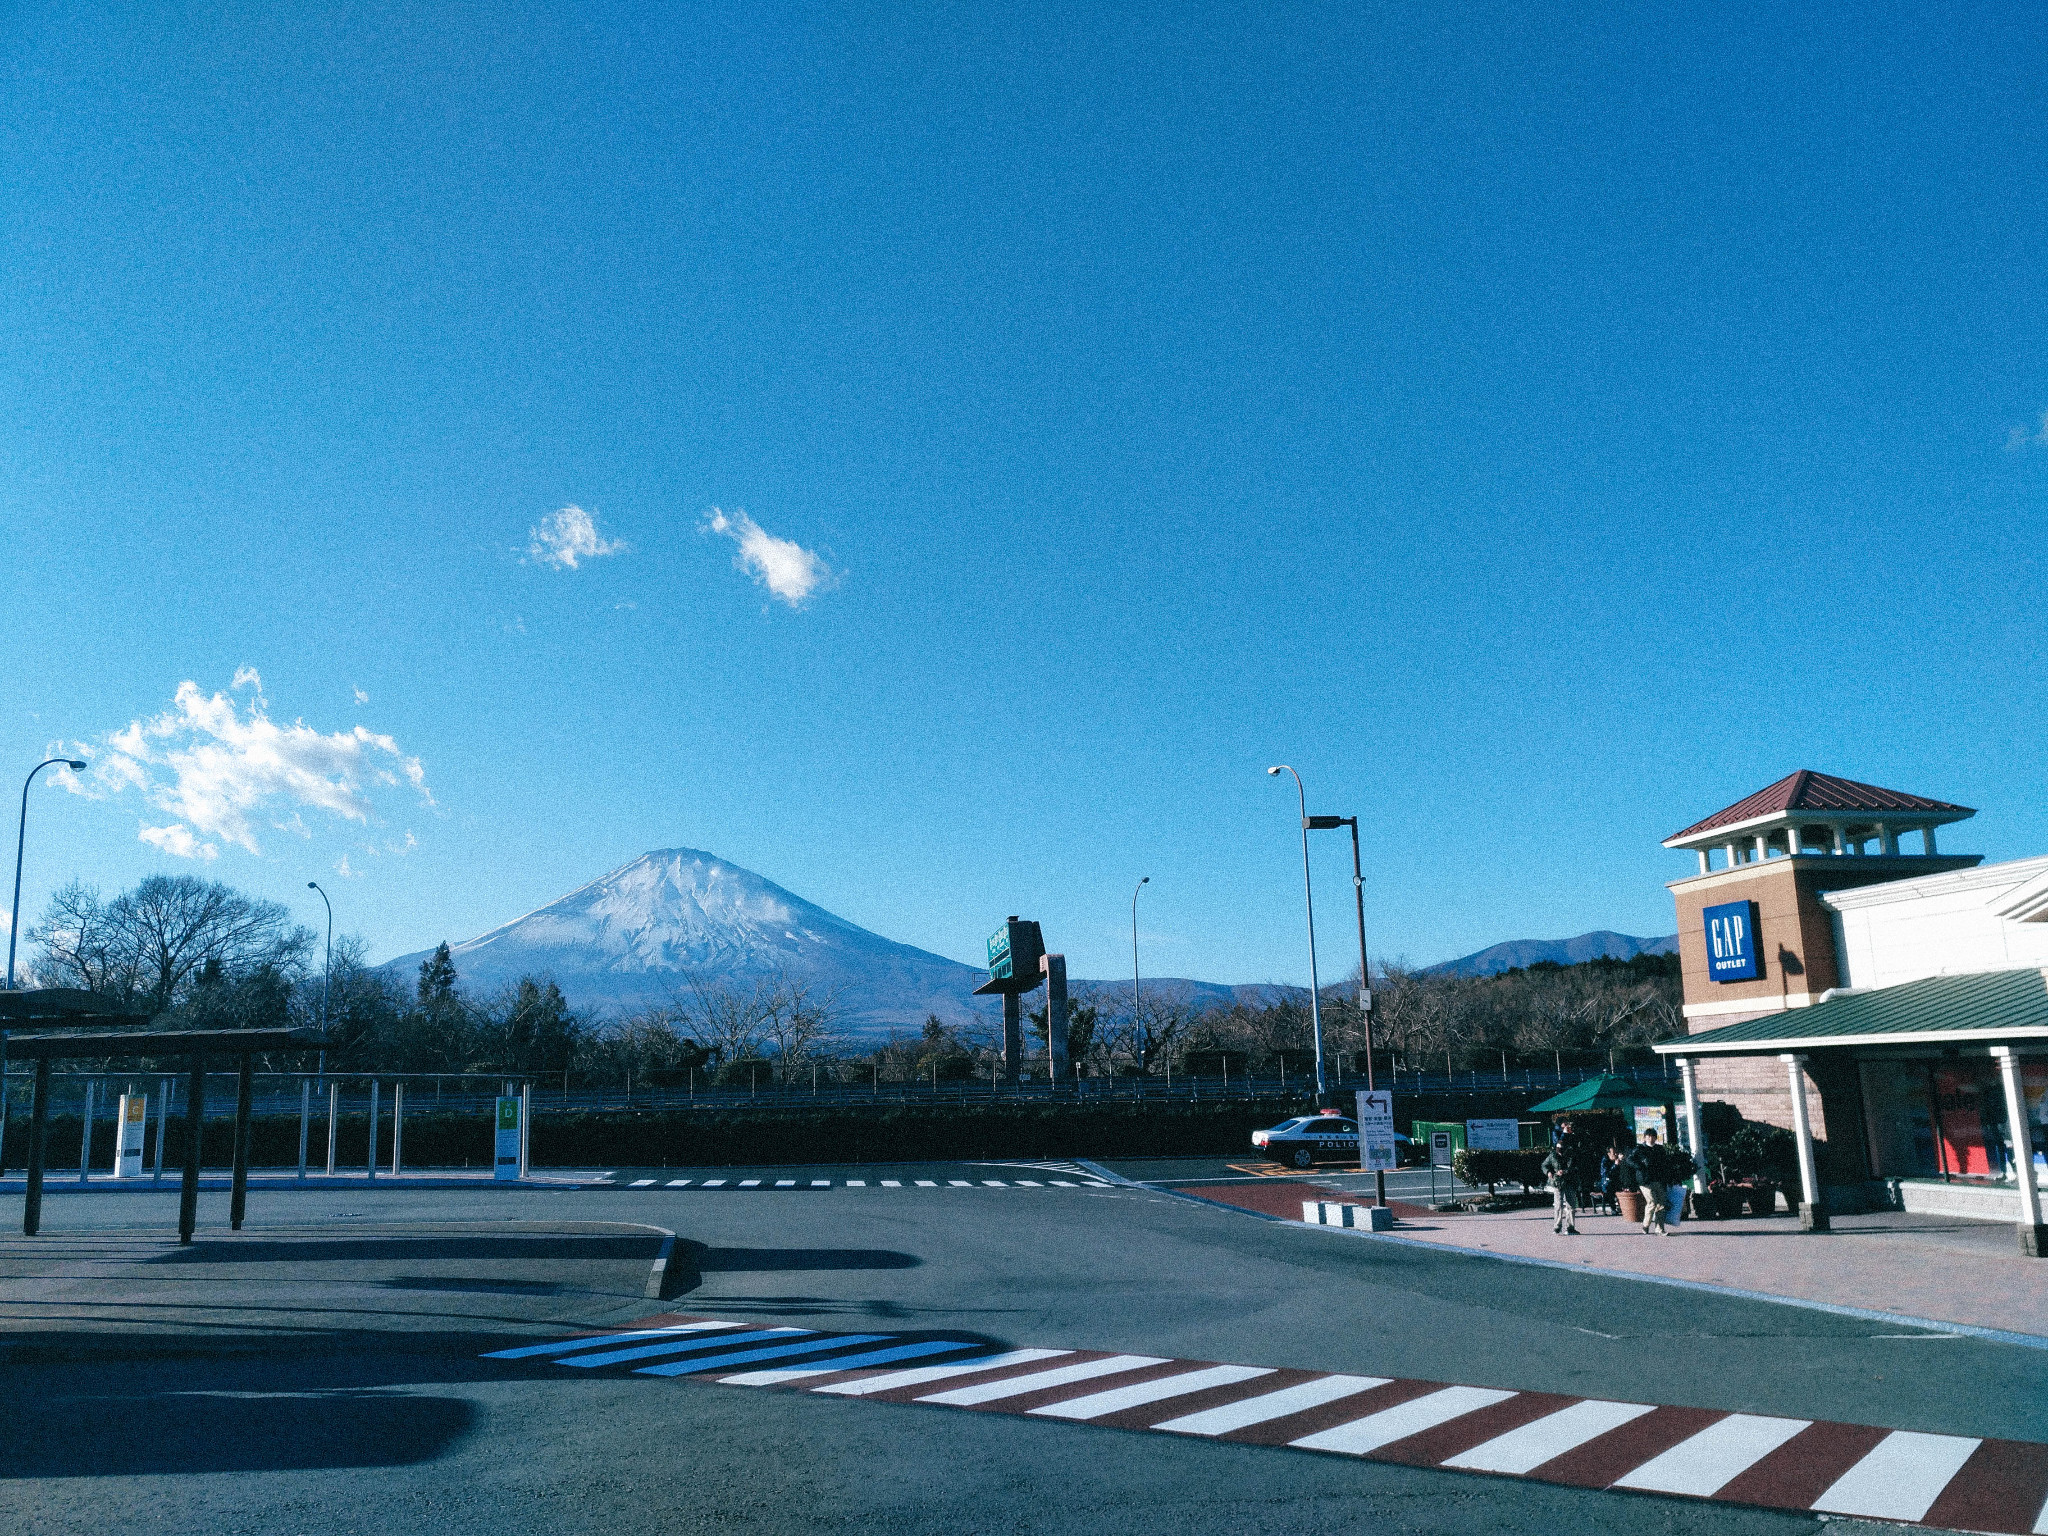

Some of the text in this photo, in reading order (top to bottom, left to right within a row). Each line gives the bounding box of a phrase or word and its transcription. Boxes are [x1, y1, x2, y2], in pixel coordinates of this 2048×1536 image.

[1711, 915, 1744, 958] GAP
[1715, 958, 1747, 970] OUTLET
[132, 1106, 139, 1115] C
[504, 1108, 513, 1118] D
